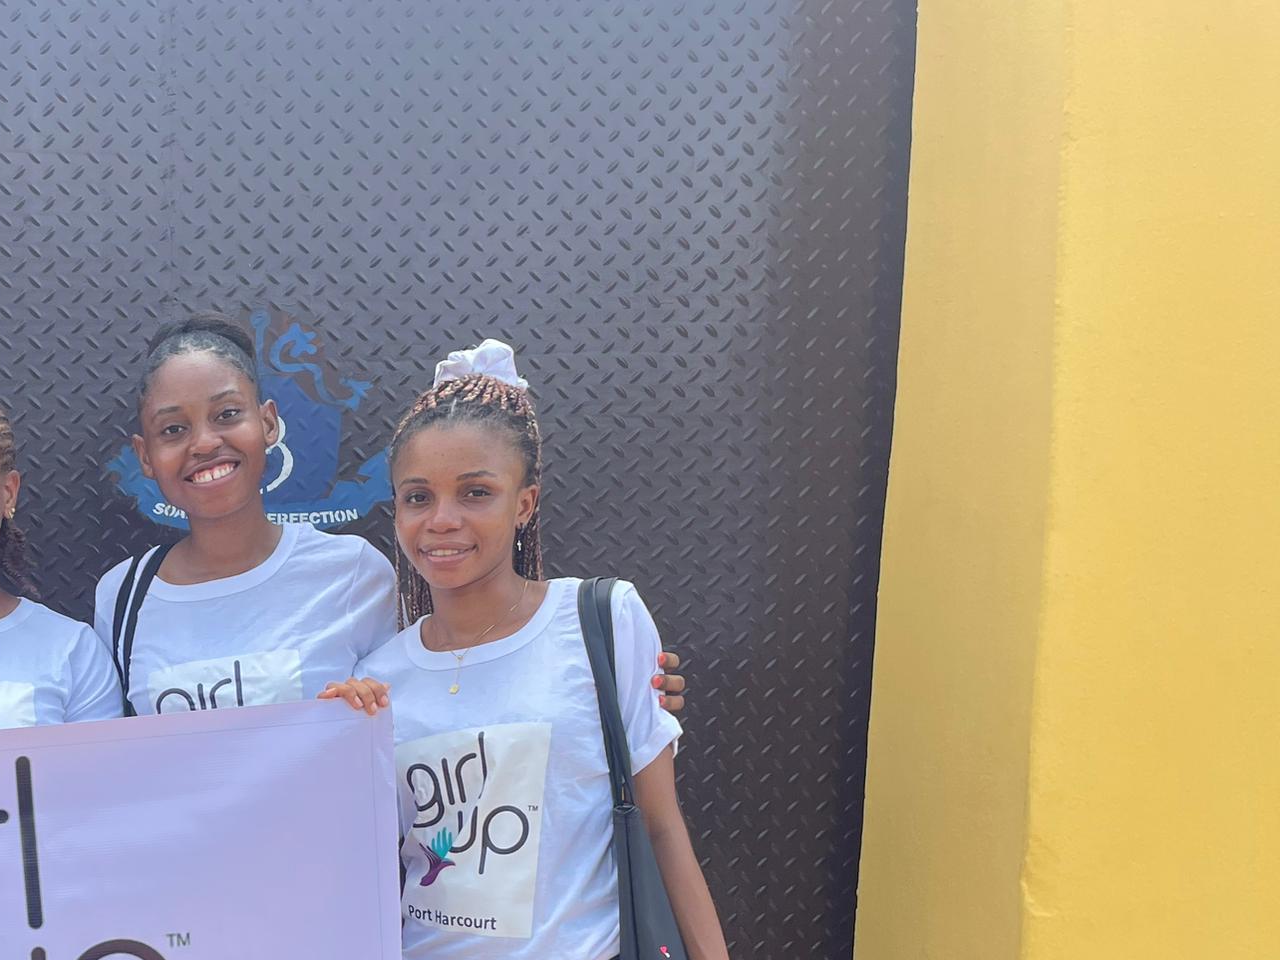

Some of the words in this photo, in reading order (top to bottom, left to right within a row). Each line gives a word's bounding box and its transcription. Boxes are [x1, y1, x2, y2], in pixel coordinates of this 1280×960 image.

[152, 502, 189, 519] SOA
[265, 508, 359, 524] ERFECTION
[406, 731, 488, 828] girl
[449, 805, 530, 875] up
[408, 904, 433, 921] Port
[435, 910, 497, 930] Harcourt
